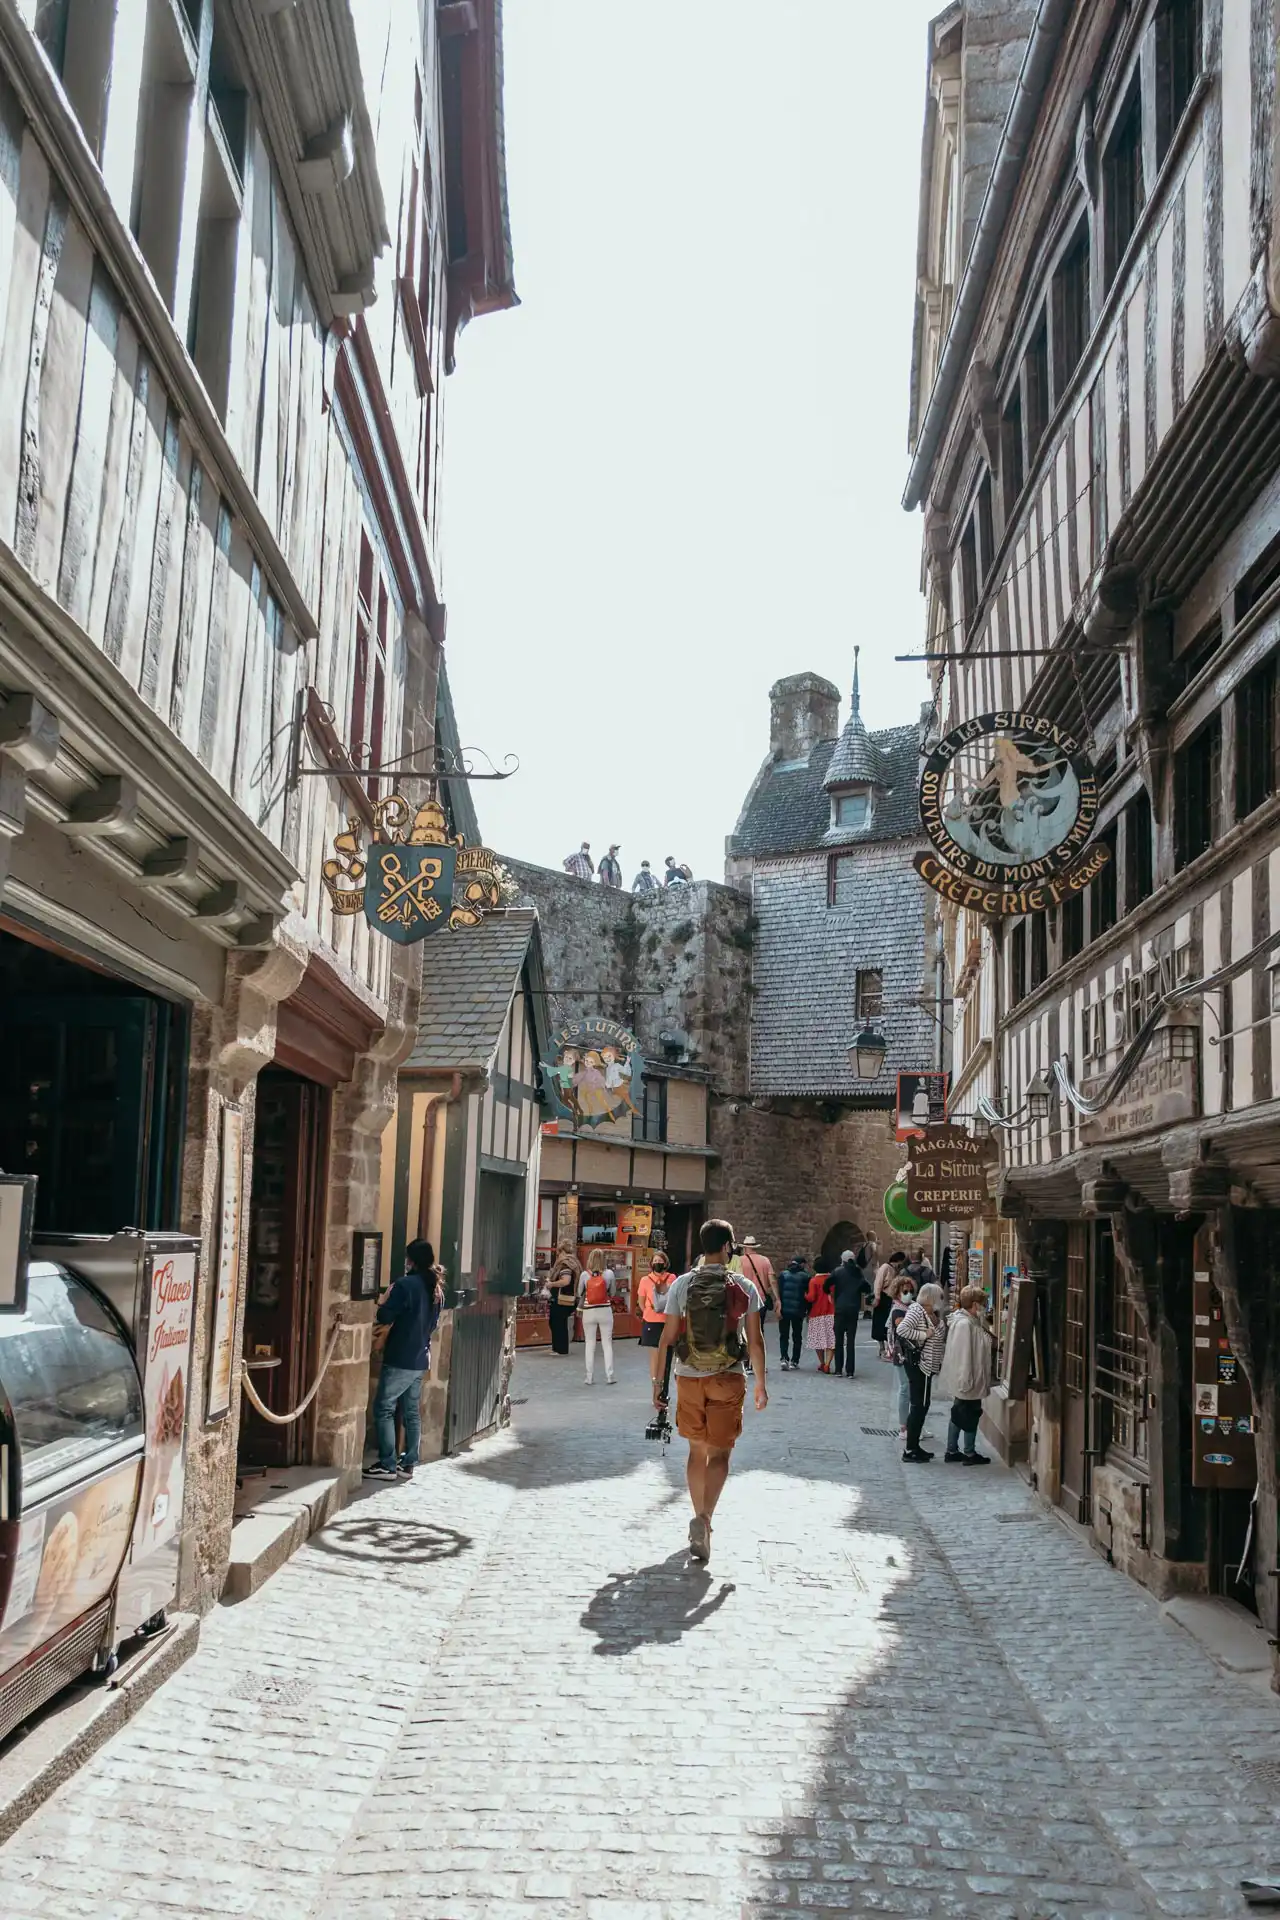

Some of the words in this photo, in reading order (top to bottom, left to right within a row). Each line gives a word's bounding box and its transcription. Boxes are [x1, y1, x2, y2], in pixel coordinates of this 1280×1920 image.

[994, 713, 1078, 755] SIRENE
[922, 770, 972, 869] SOUVENIRS
[974, 862, 998, 881] DU
[1004, 855, 1055, 883] MONT
[1069, 773, 1097, 846] MICHEL
[554, 1024, 580, 1048] LES
[585, 1021, 638, 1053] LUTINS
[914, 1139, 980, 1155] MAGASIN
[914, 1161, 934, 1177] La
[940, 1159, 982, 1181] Sirène
[920, 1205, 933, 1213] au
[949, 1203, 975, 1215] étage
[153, 1260, 192, 1314] Glaces
